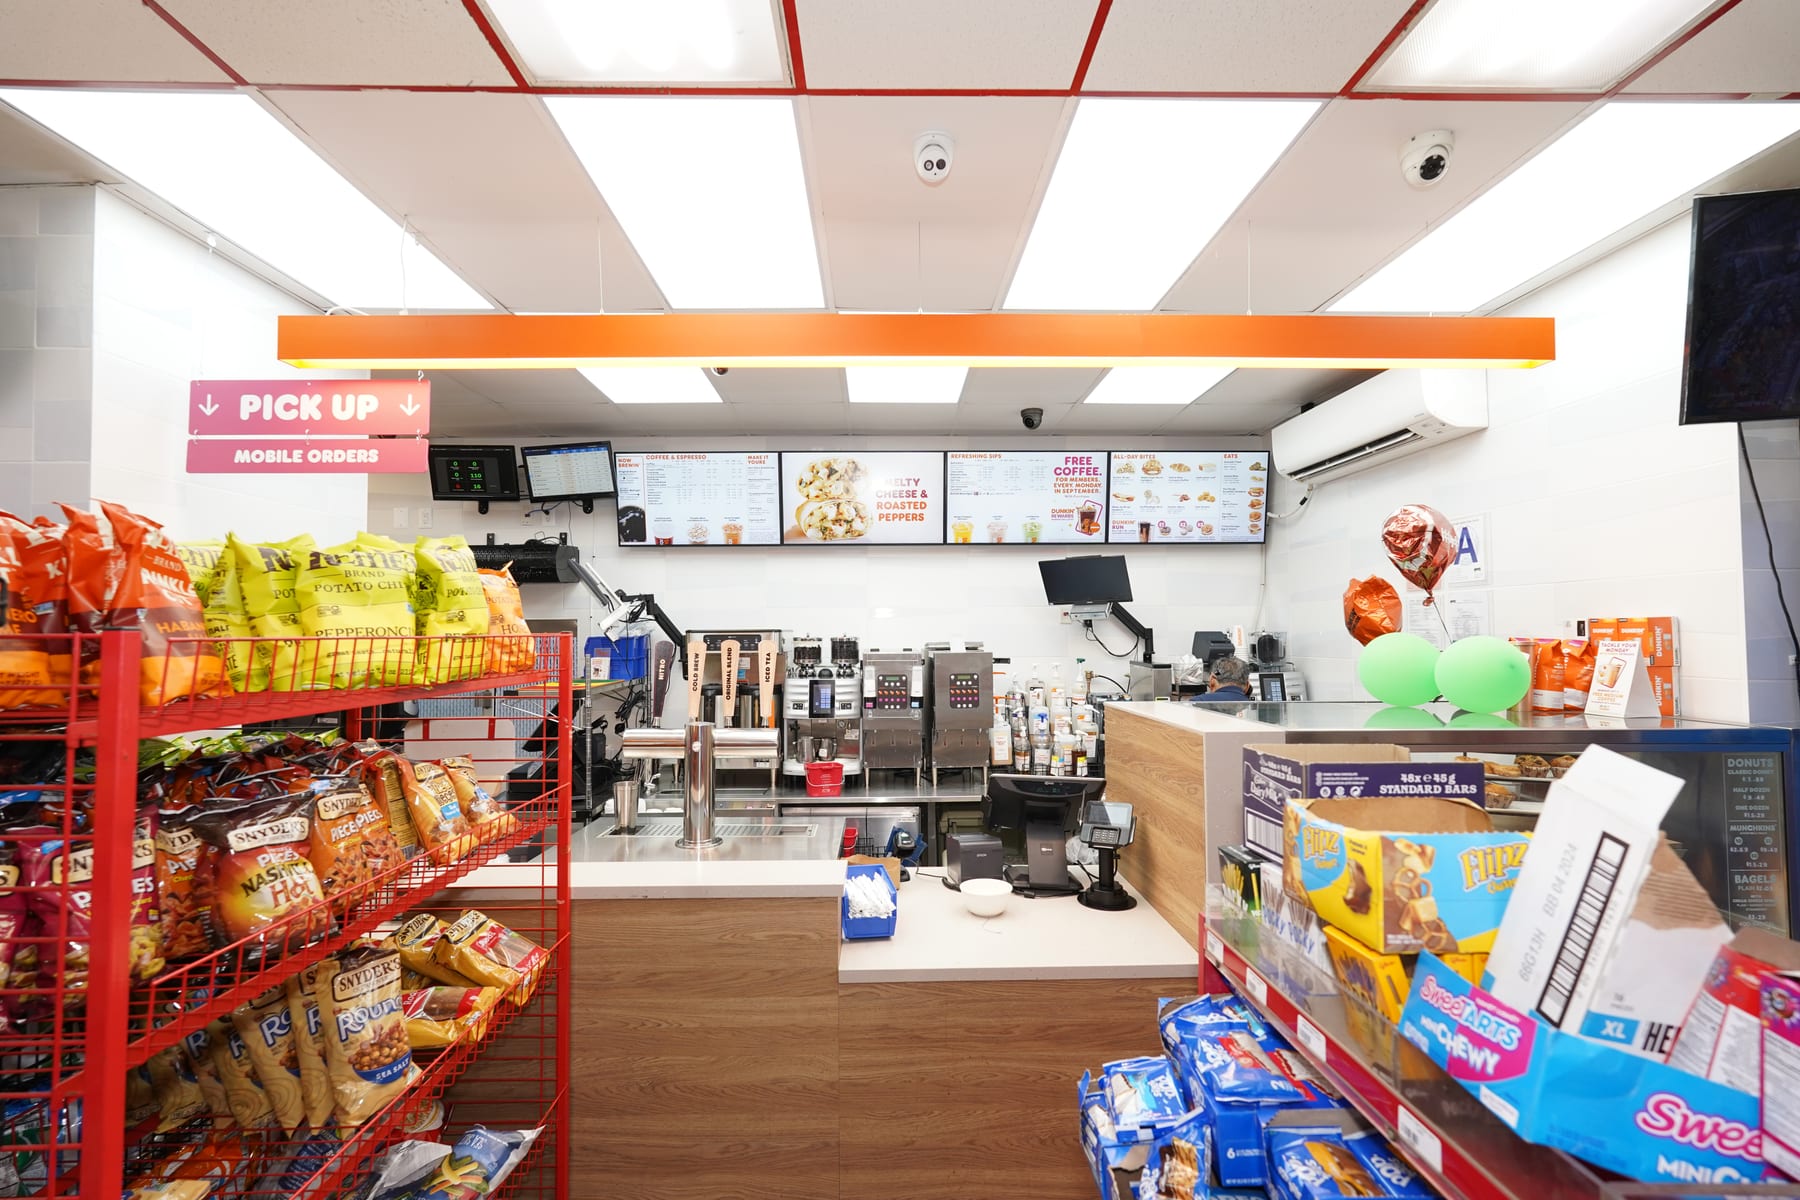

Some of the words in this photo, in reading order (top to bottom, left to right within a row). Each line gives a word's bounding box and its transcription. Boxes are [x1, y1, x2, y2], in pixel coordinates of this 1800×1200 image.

[239, 394, 322, 421] PICK
[332, 394, 379, 421] UP
[233, 449, 303, 463] MOBILE
[307, 449, 379, 463] ORDERS
[1064, 456, 1093, 466] FREE
[1053, 467, 1103, 476] COFFEE.
[876, 489, 918, 498] CHEESE
[920, 489, 928, 498] &
[876, 501, 927, 510] ROASTED
[878, 513, 925, 522] PEPPERS
[1453, 526, 1478, 565] A
[153, 555, 181, 572] BRAND
[344, 570, 386, 578] BRAND
[314, 581, 373, 593] POTATO
[1654, 625, 1663, 657] DUNKIN'
[658, 659, 666, 680] NITRO
[1727, 758, 1773, 768] DONUTS
[1286, 774, 1301, 784] BARS
[1400, 773, 1421, 783] 48x
[1379, 784, 1442, 794] STANDARD
[1444, 784, 1477, 794] BARS
[1729, 824, 1776, 832] MUNCHKINS
[1302, 825, 1340, 860] Flipz
[1460, 842, 1529, 890] Flipz
[1560, 842, 1578, 877] 2024
[1734, 874, 1777, 884] BAGELS
[269, 874, 314, 911] Hot
[339, 957, 401, 992] SNYDER'S
[1601, 1019, 1626, 1039] XL
[1642, 1020, 1682, 1055] HE
[1437, 1022, 1500, 1076] CHEWY
[376, 1069, 392, 1081] SEA
[392, 1058, 410, 1073] SALT
[1226, 1147, 1236, 1159] 6
